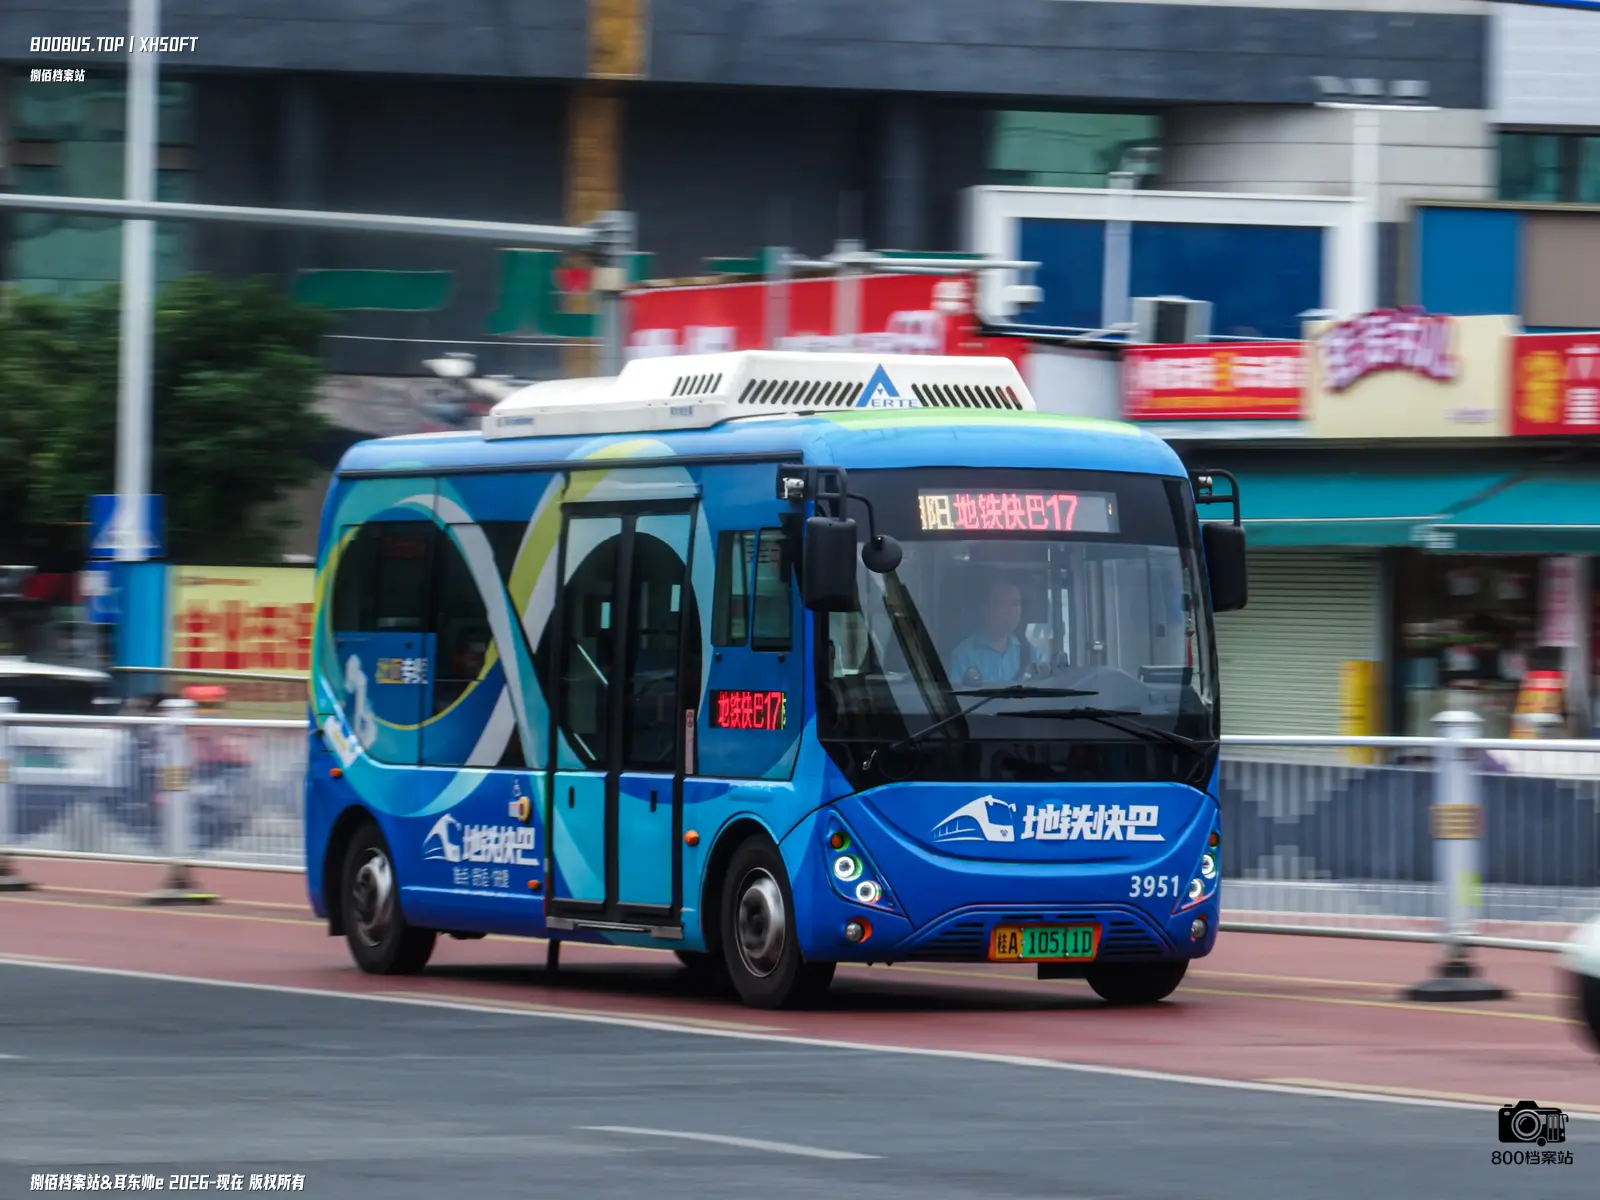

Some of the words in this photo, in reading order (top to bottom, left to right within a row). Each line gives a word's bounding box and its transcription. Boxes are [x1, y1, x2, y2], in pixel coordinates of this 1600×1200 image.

[1021, 804, 1165, 842] 地铁快巴
[1128, 875, 1180, 898] 3951
